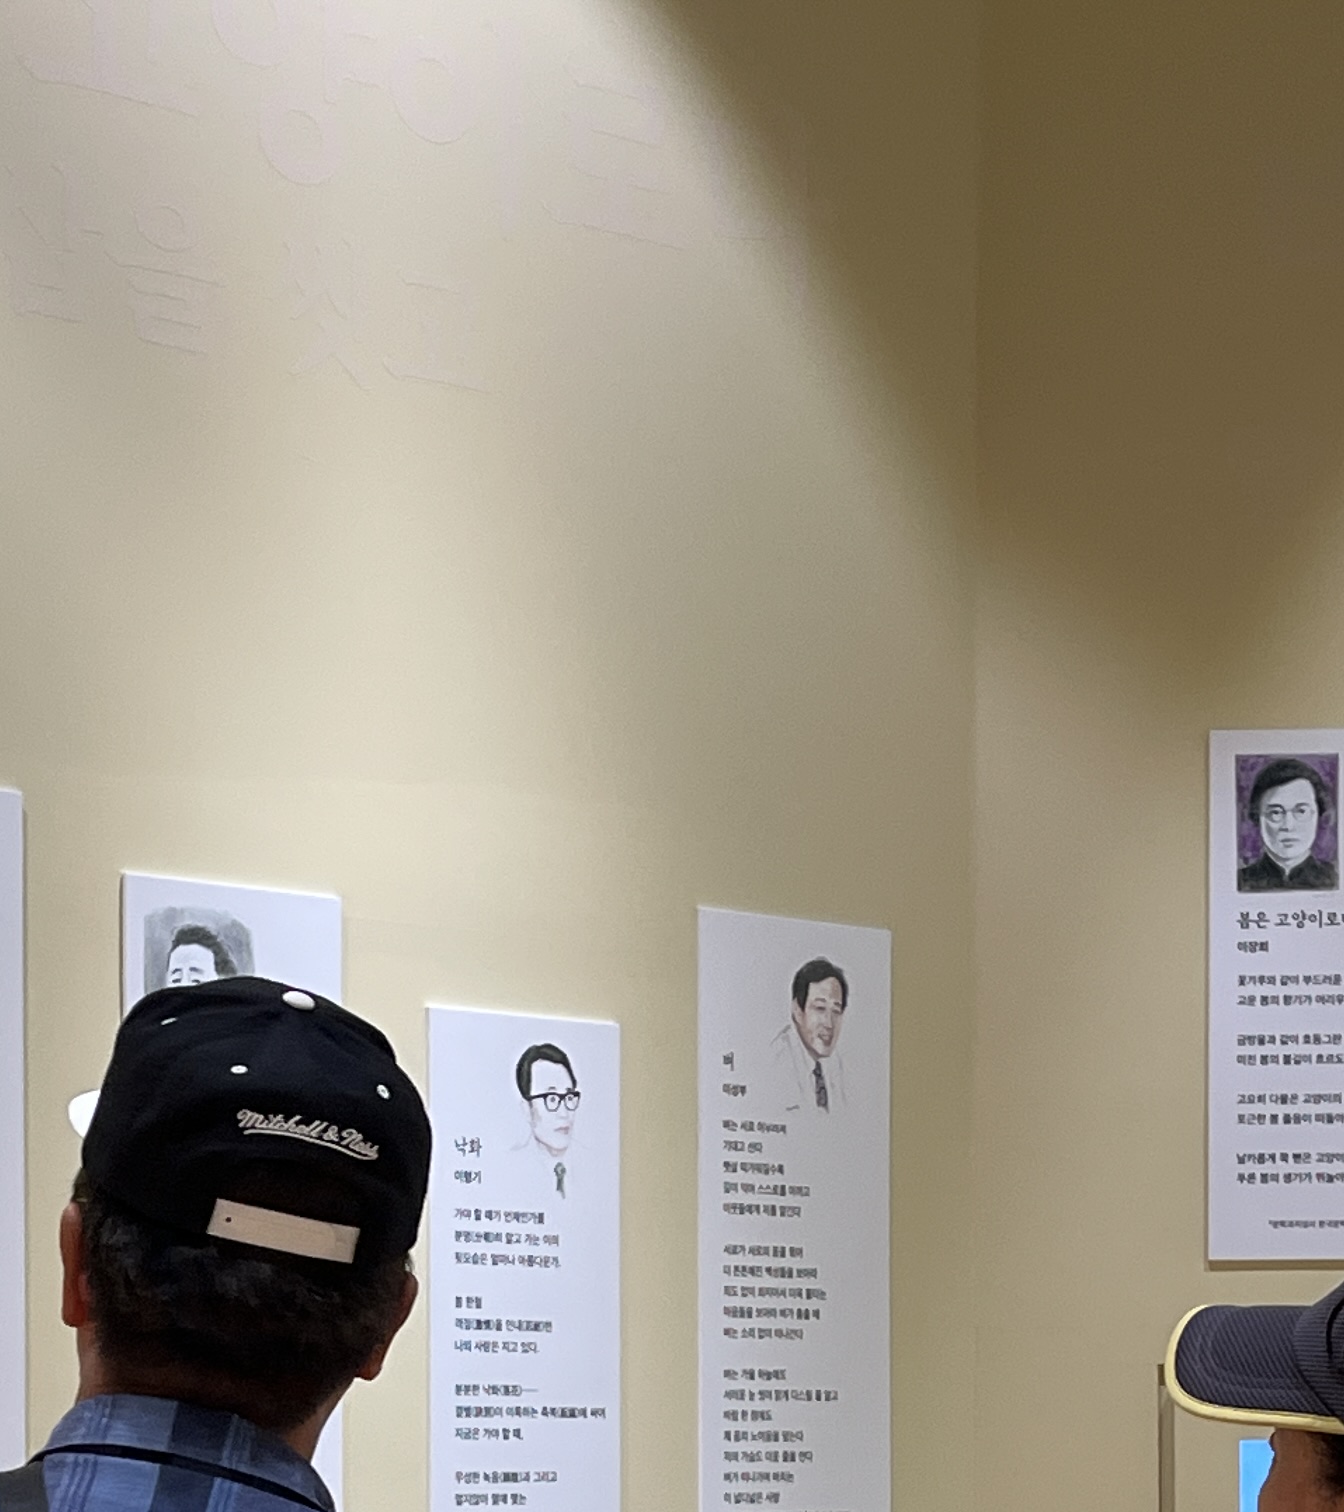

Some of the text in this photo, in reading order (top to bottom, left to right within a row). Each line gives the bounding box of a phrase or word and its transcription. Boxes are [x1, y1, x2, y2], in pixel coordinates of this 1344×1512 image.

[1236, 911, 1270, 930] 봄은
[236, 1109, 380, 1157] Mitchell & Ness
[454, 1137, 482, 1157] 낙화
